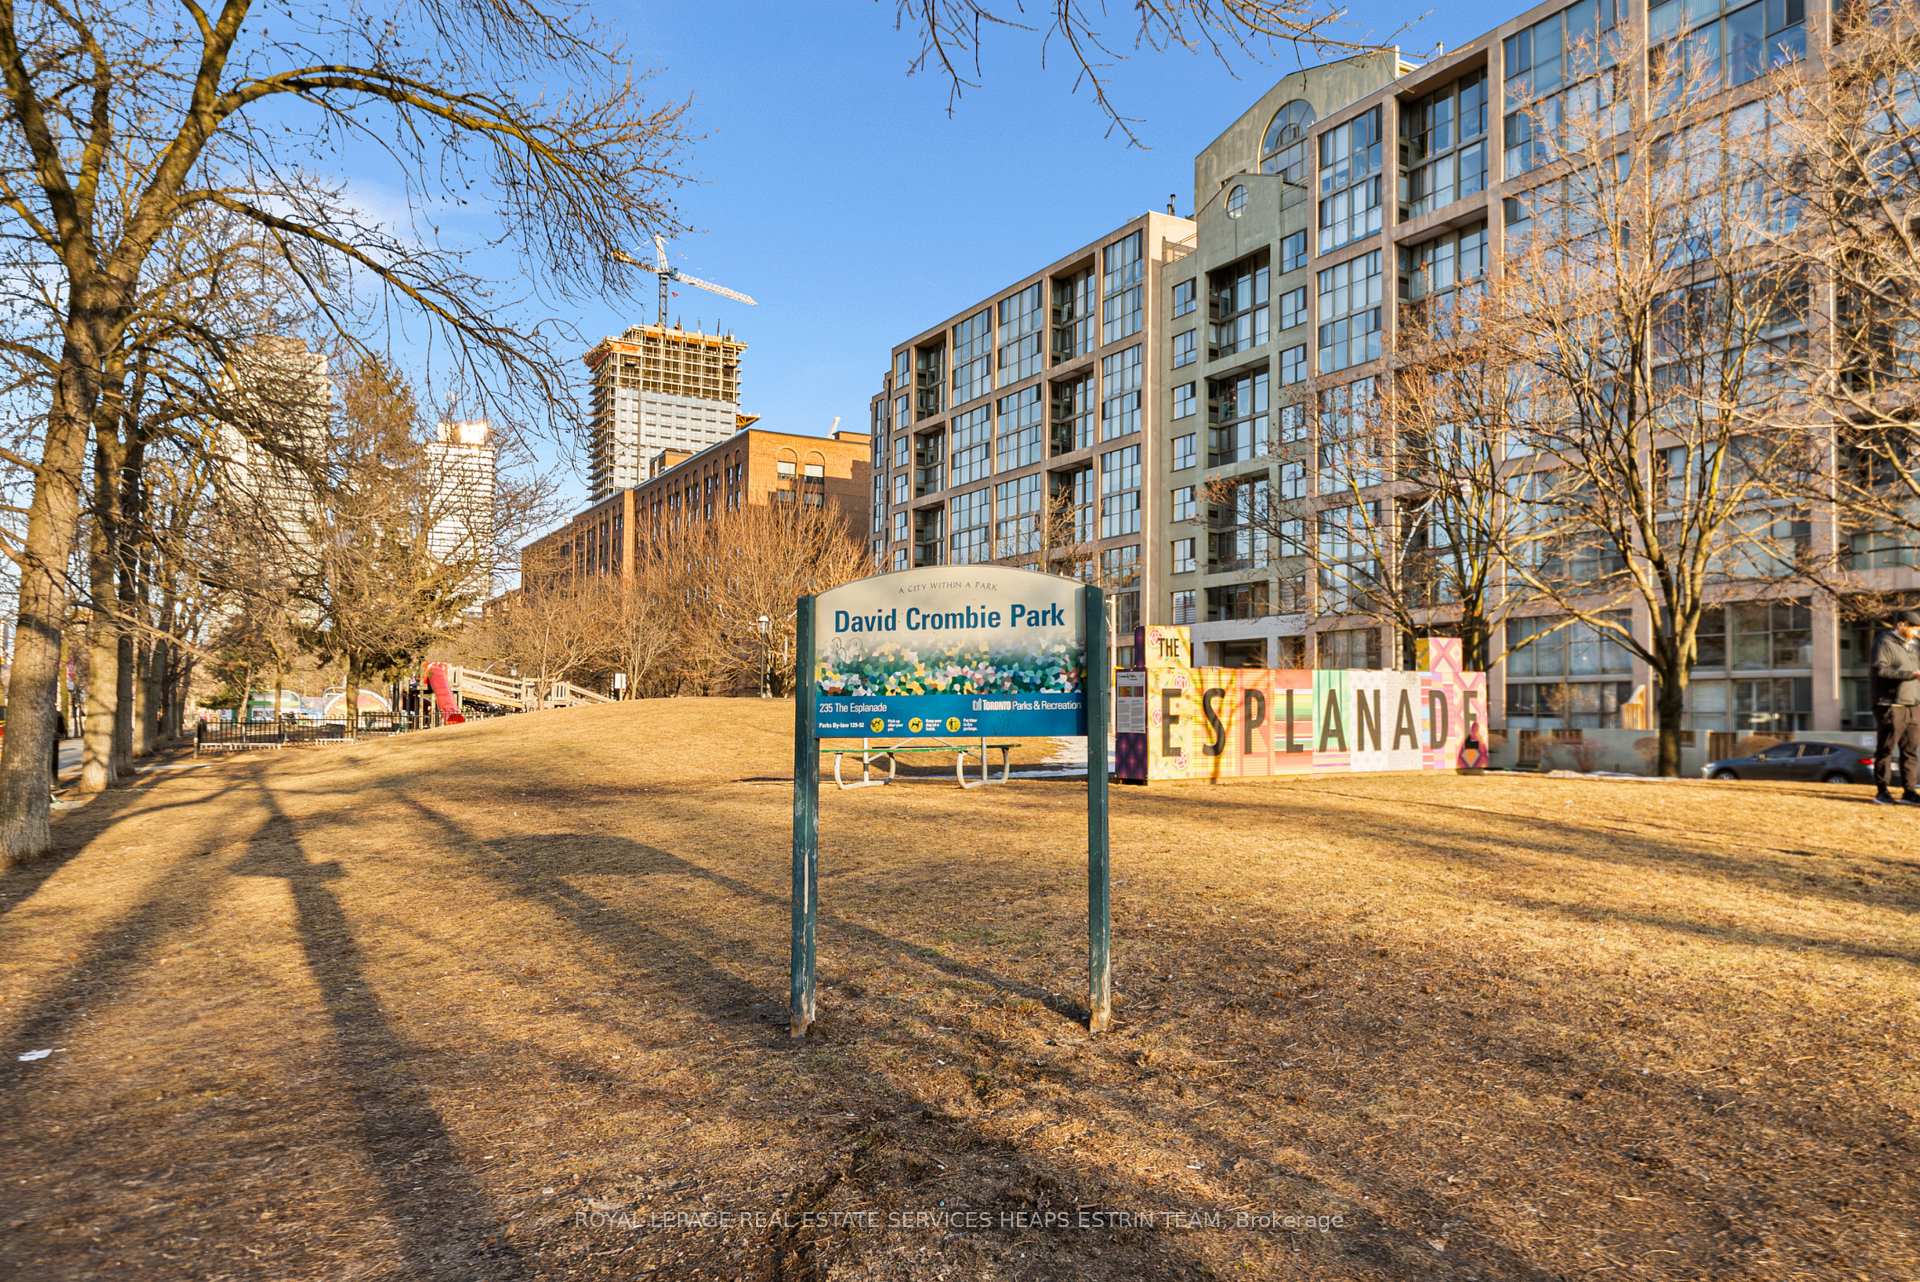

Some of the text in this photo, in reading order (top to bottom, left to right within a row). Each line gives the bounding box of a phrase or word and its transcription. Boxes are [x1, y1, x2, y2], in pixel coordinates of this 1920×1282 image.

[898, 581, 998, 594] A CITY WITHIN A PARK
[834, 602, 1065, 633] David Crombie Park
[1158, 638, 1180, 657] THE
[819, 703, 887, 714] 235 The Esplanade
[983, 699, 1082, 711] TORONTO Parks & Recreation
[1161, 687, 1478, 757] ESPLANADE
